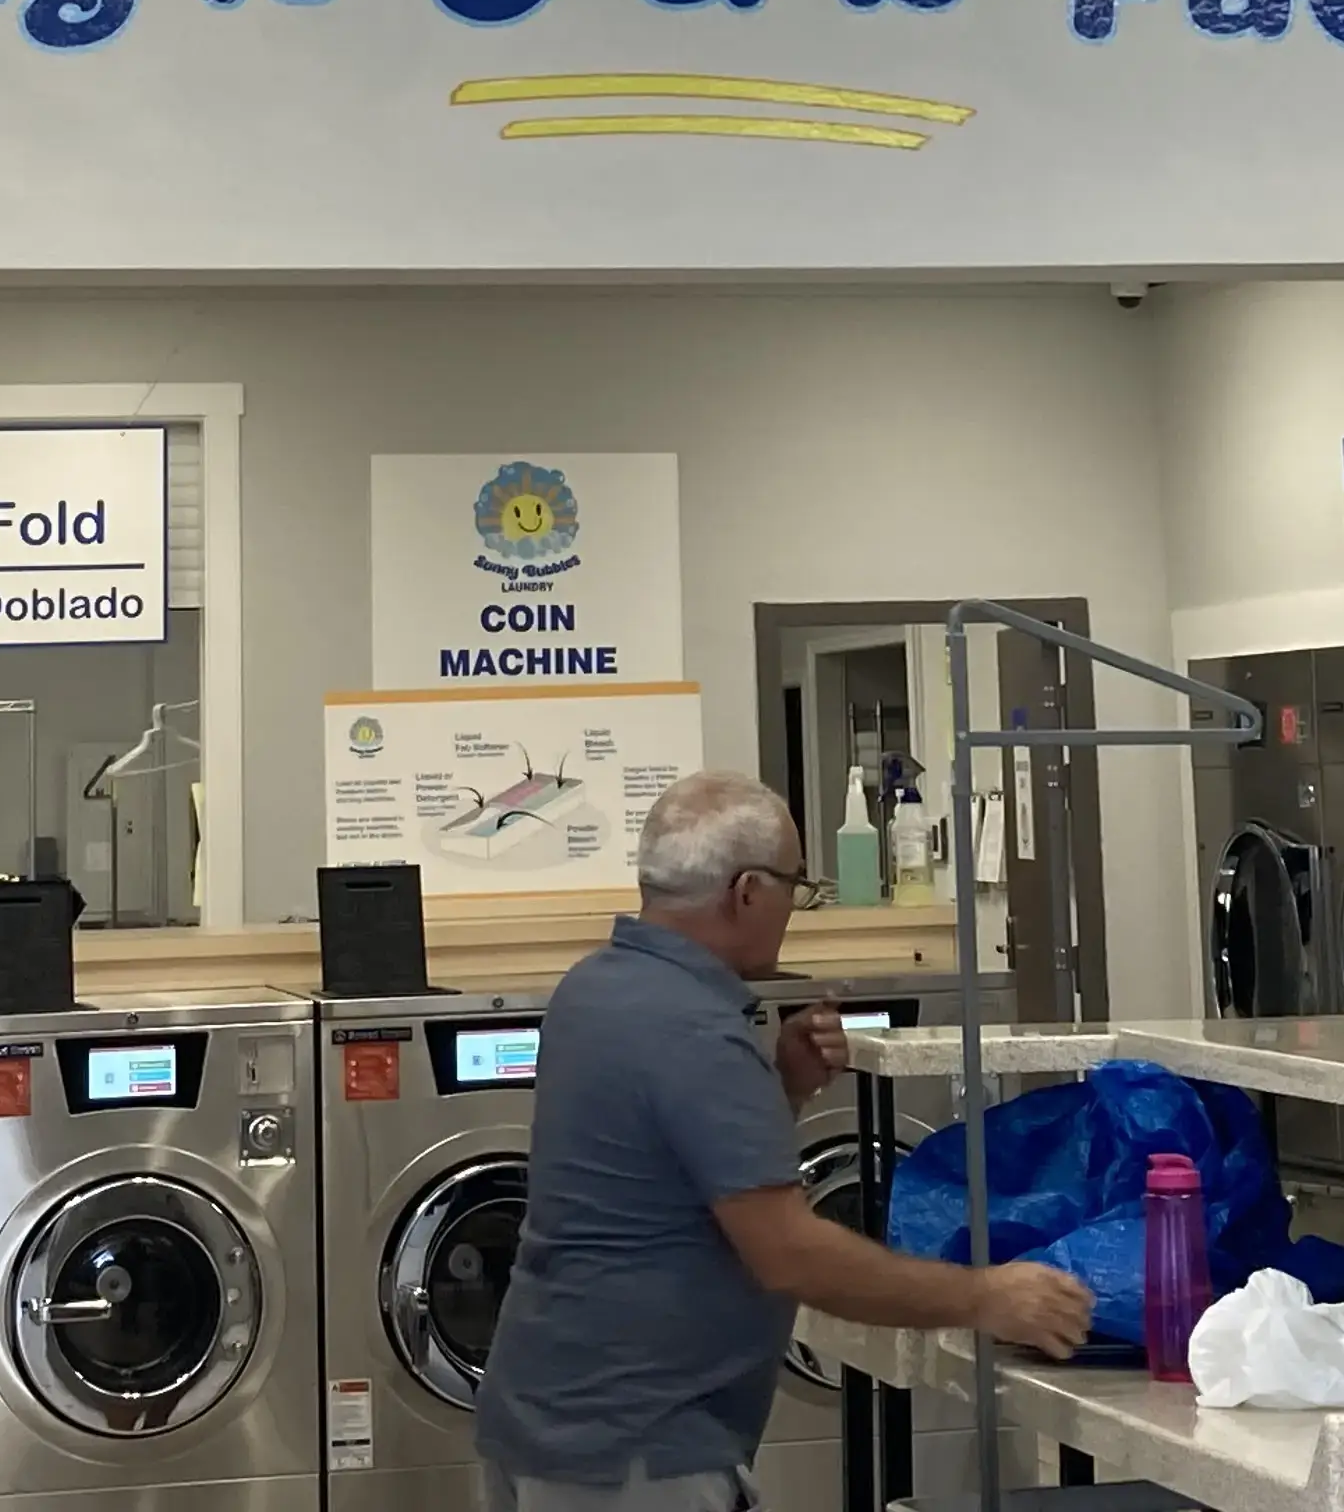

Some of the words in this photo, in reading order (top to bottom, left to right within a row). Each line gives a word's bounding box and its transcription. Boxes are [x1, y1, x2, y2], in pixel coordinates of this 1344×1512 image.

[473, 554, 519, 580] Sunny
[522, 554, 581, 578] Bubbles
[501, 581, 555, 594] LAUNDRY
[480, 604, 575, 633] COIN
[440, 646, 618, 677] MACHINE
